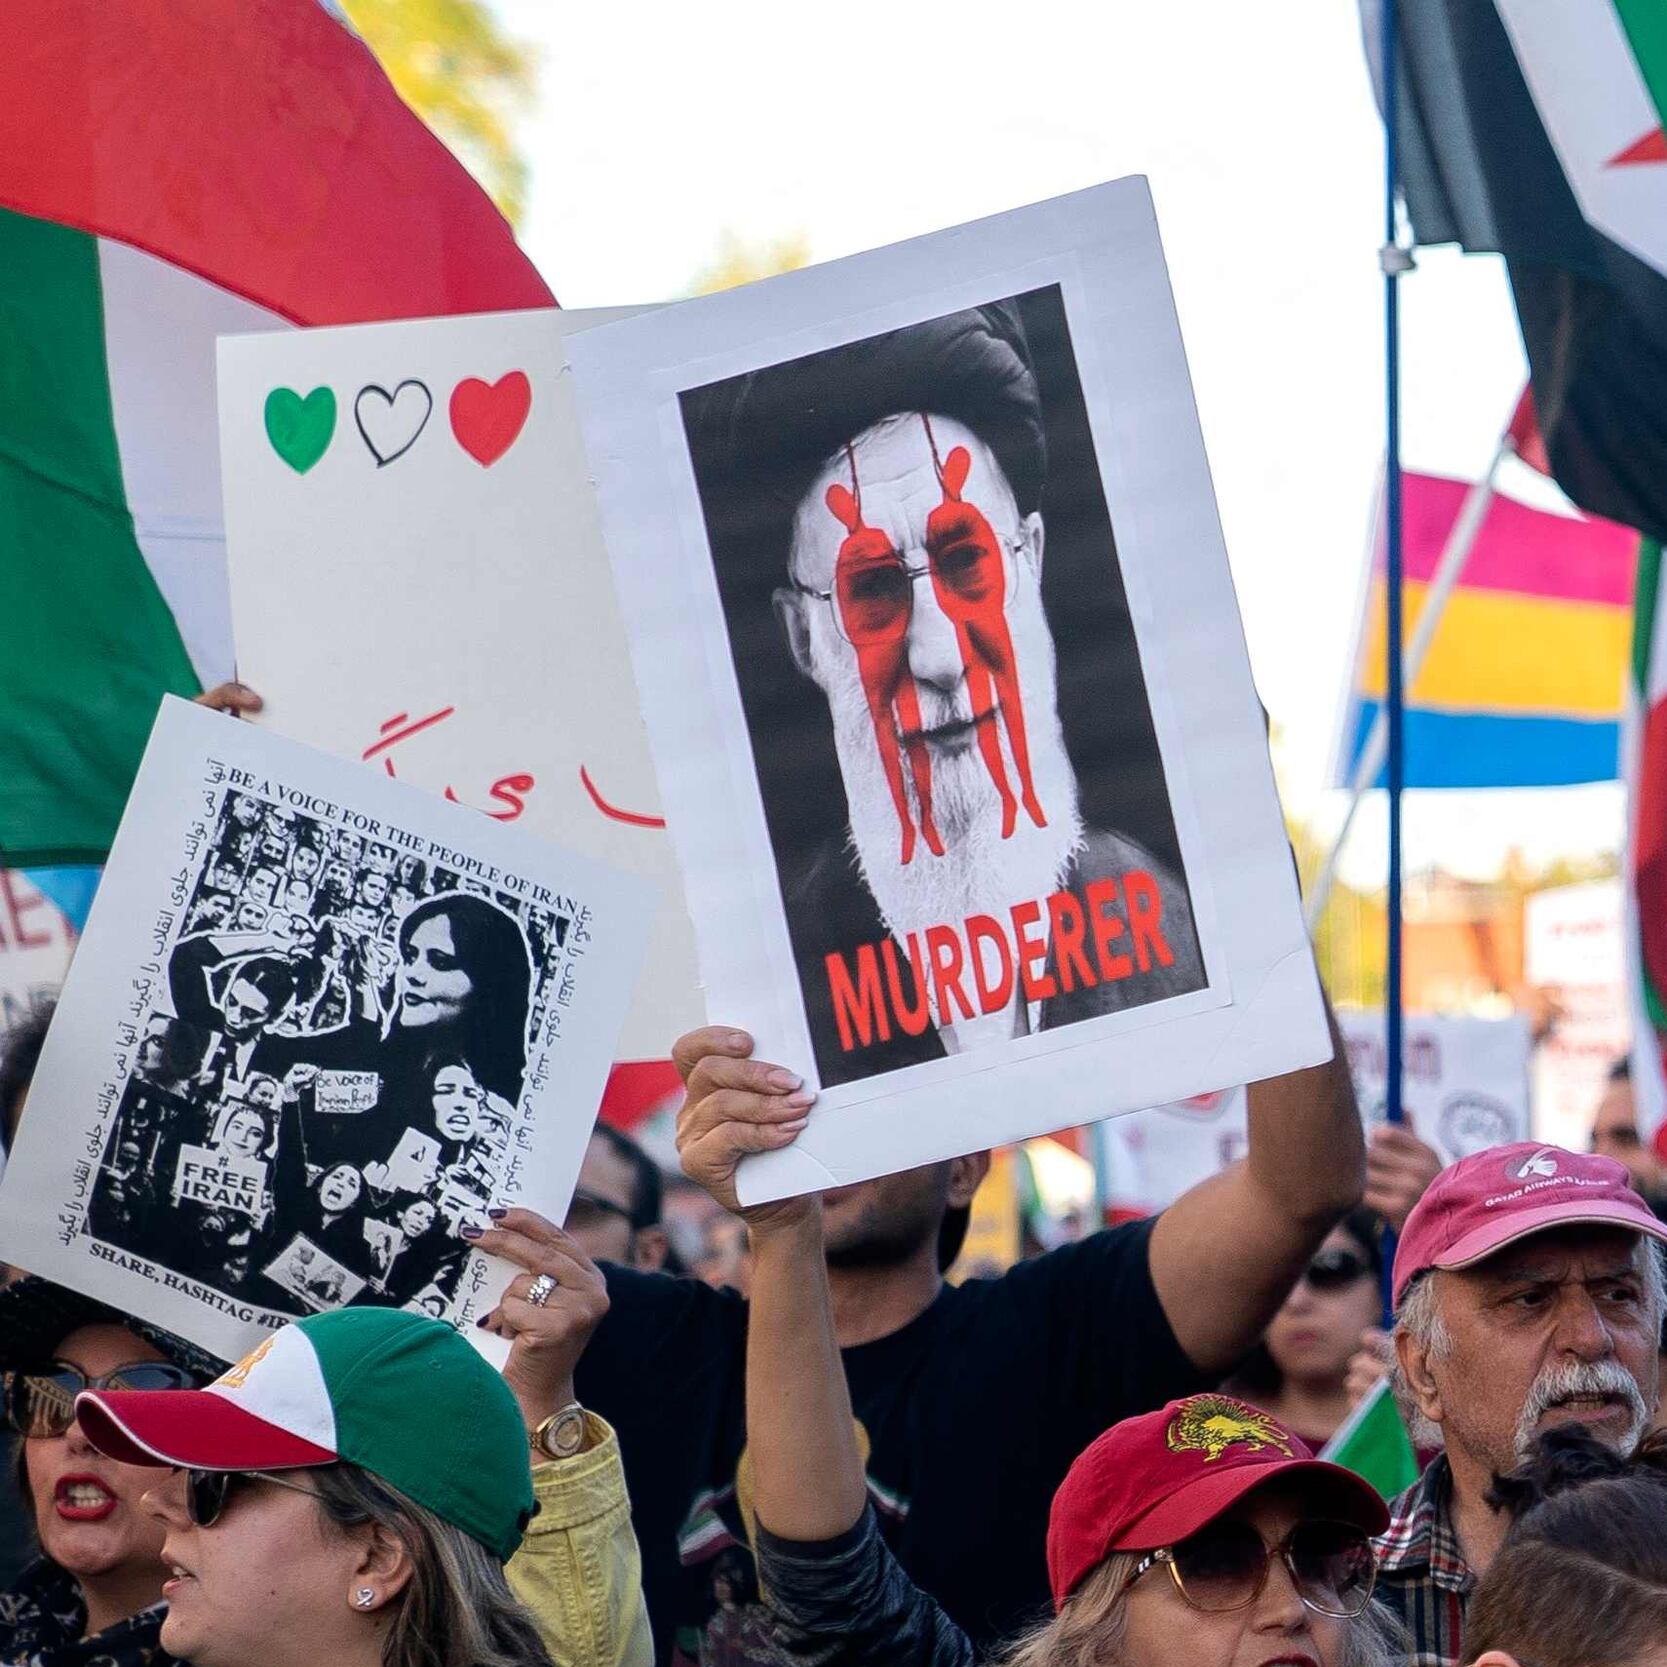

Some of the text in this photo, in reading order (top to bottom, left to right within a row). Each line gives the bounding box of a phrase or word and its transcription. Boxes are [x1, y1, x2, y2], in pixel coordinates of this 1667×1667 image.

[228, 767, 578, 916] BE A VOICE FOR THE PEOPLE OF IRAN
[825, 869, 1175, 1051] MURDERER
[181, 1179, 253, 1211] IRAN
[183, 1162, 258, 1194] FREE
[1485, 1188, 1523, 1208] QATAR
[88, 1242, 161, 1284] SHARE,
[162, 1272, 254, 1323] HASHTAG
